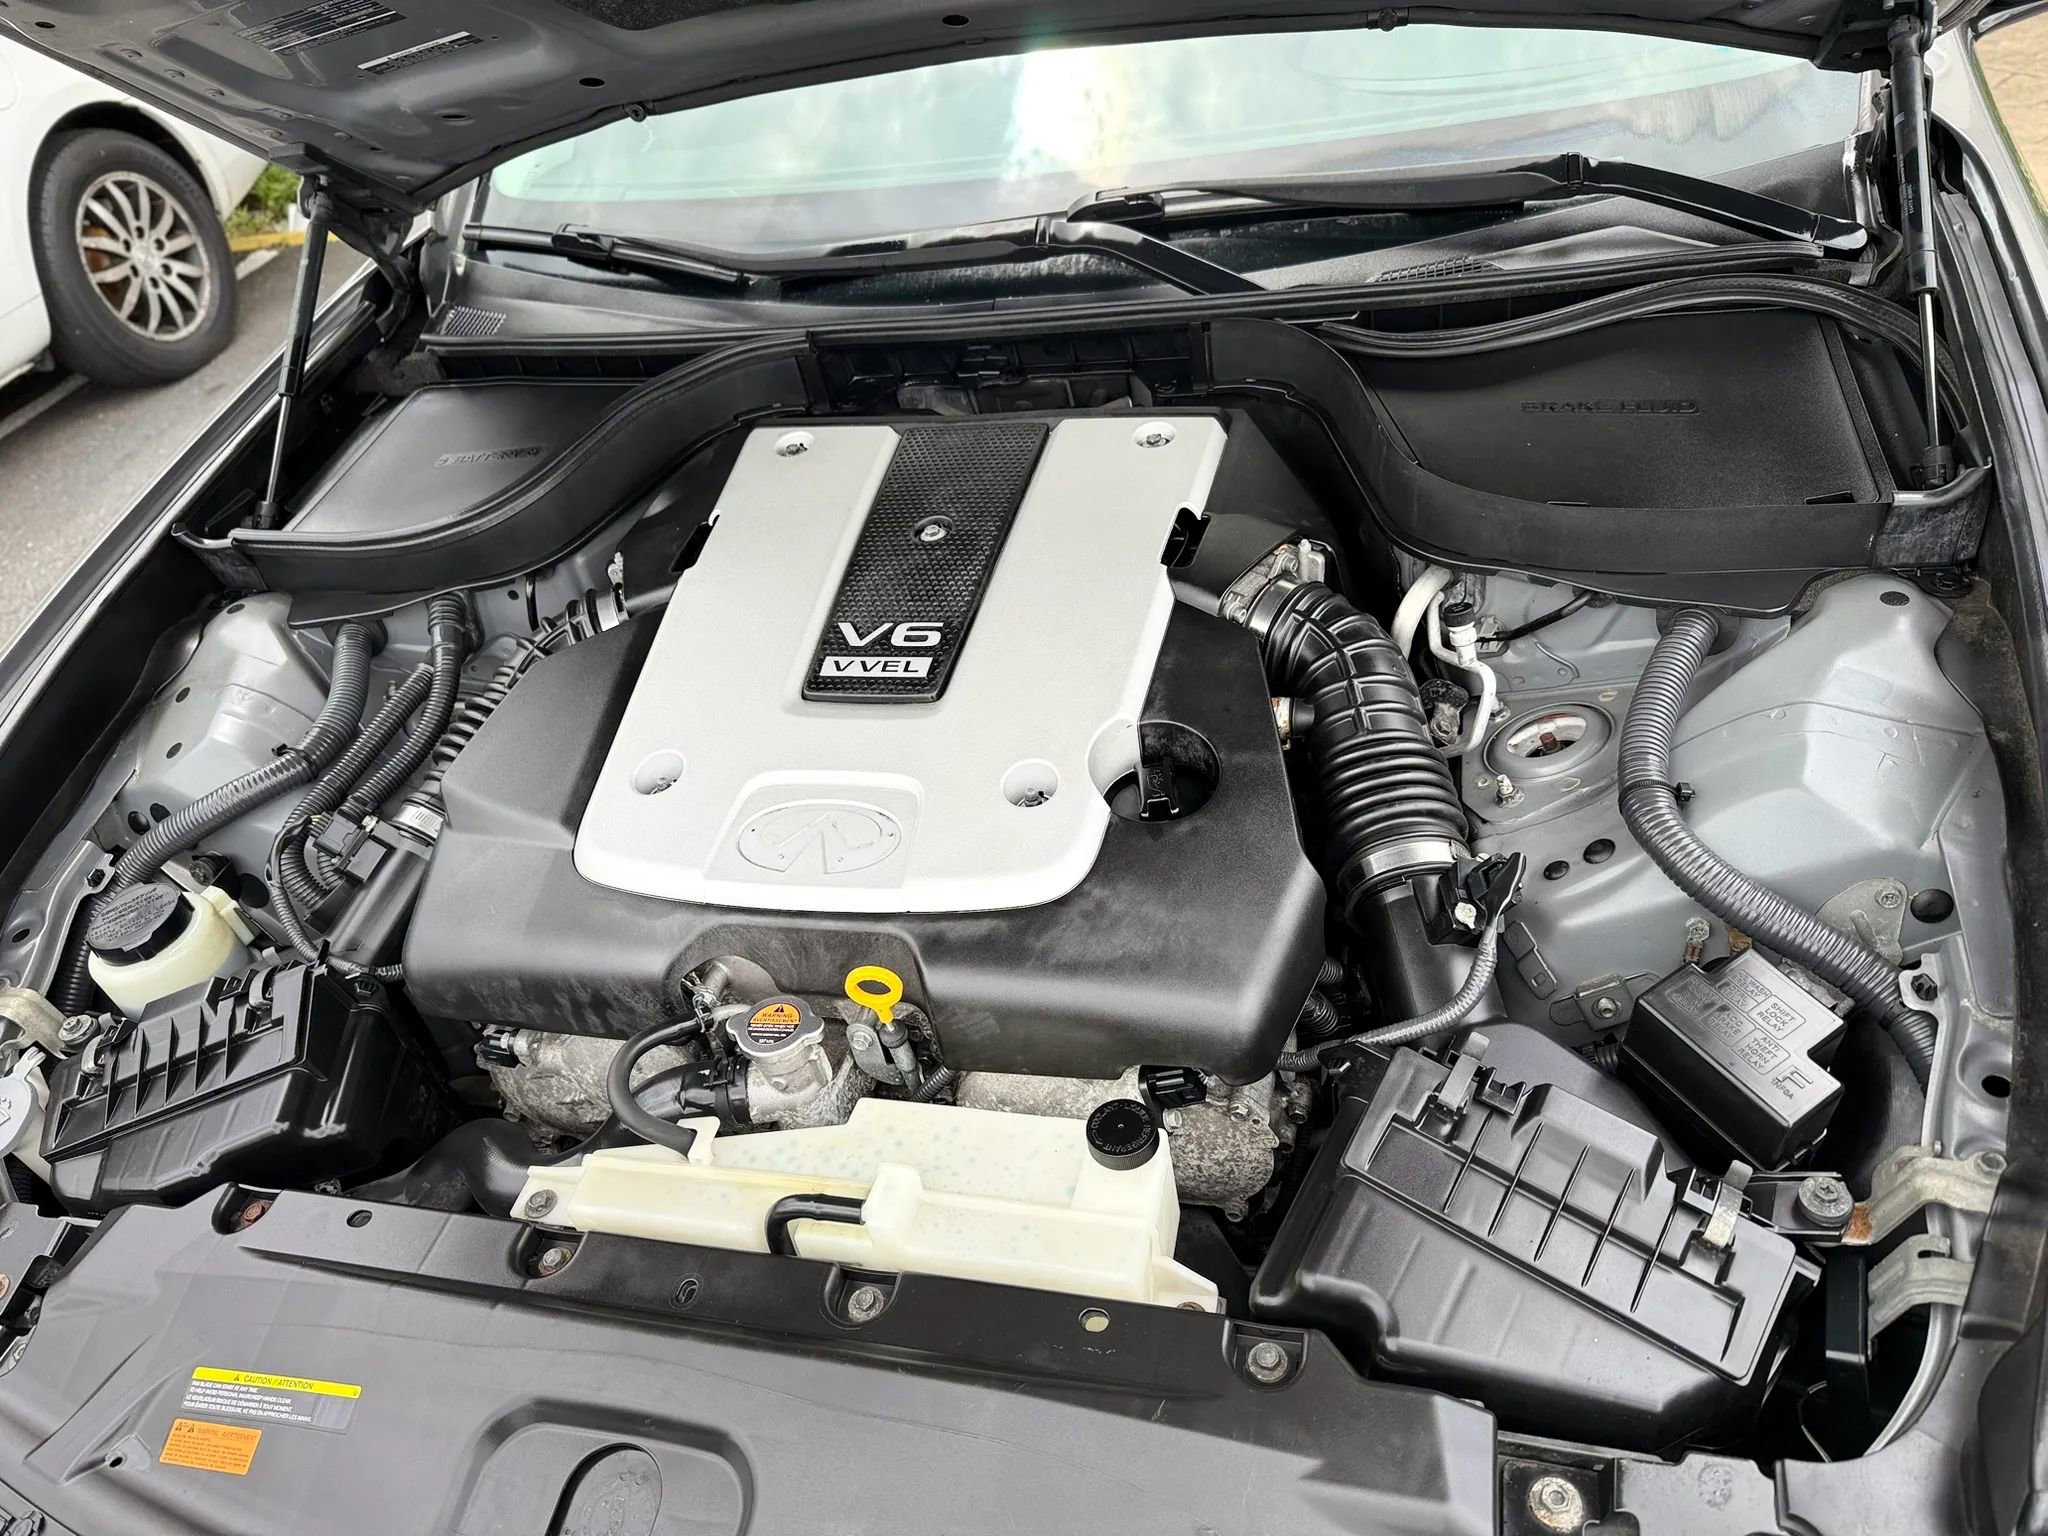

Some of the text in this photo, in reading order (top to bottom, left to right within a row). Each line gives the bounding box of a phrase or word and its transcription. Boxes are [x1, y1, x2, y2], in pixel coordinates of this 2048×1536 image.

[1520, 399, 1699, 415] BRAKE FLUID
[838, 622, 944, 647] V6
[833, 660, 919, 673] VVEL
[1756, 1011, 1784, 1032] RELAY
[1764, 1007, 1788, 1026] LOCK
[1770, 1002, 1796, 1021] SHIFT
[1714, 1013, 1741, 1036] BRAKE
[1745, 1043, 1770, 1064] HORN
[1752, 1037, 1778, 1060] THEFT
[1760, 1037, 1780, 1052] ANTI
[1737, 1048, 1764, 1069] RELAY
[244, 1374, 272, 1385] CAUTION
[278, 1378, 314, 1390] ATTENTION
